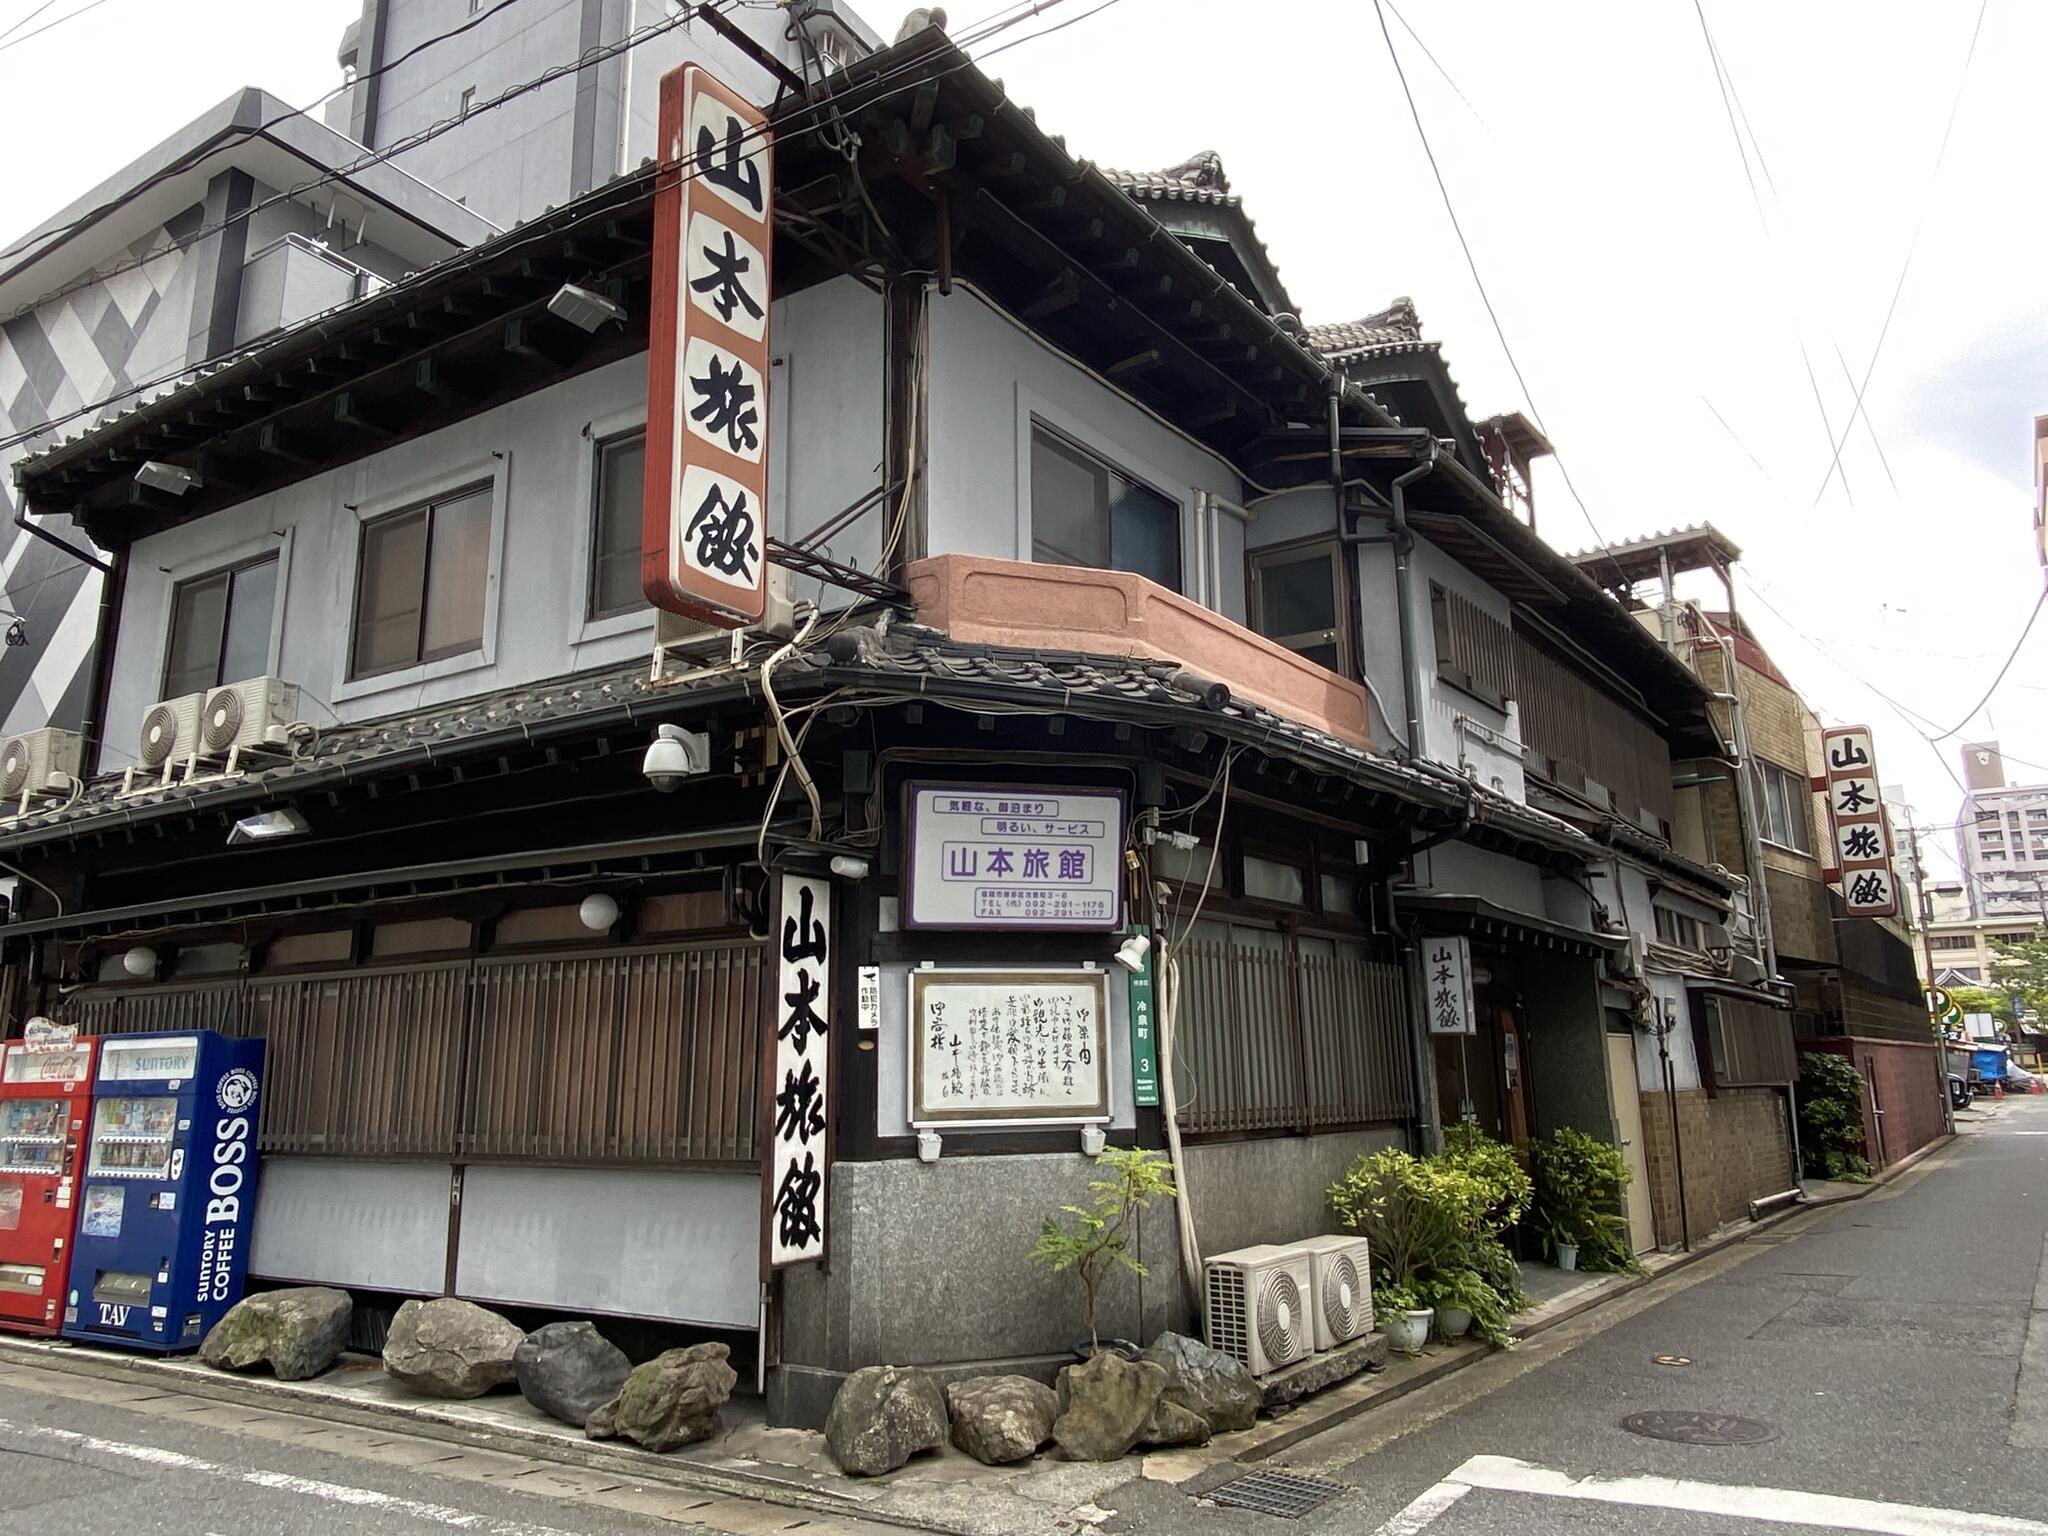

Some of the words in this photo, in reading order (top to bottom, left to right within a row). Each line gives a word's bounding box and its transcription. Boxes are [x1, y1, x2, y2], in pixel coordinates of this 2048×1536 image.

[685, 114, 766, 588] 山本旅館
[996, 821, 1090, 835] 明るい、サービス
[1832, 736, 1887, 905] 山本旅館
[951, 847, 1086, 879] 山本旅館
[981, 899, 1001, 907] TEL
[981, 908, 1002, 916] FAX
[1432, 946, 1460, 1028] 山本旅館
[1136, 1000, 1149, 1040] 冷泉町
[135, 1055, 189, 1071] SUNTORY
[773, 885, 829, 1249] 山本旅館
[1140, 1058, 1149, 1072] 3
[206, 1117, 249, 1224] BOSS
[197, 1230, 216, 1302] SUNTORY
[213, 1228, 235, 1301] COFFEE
